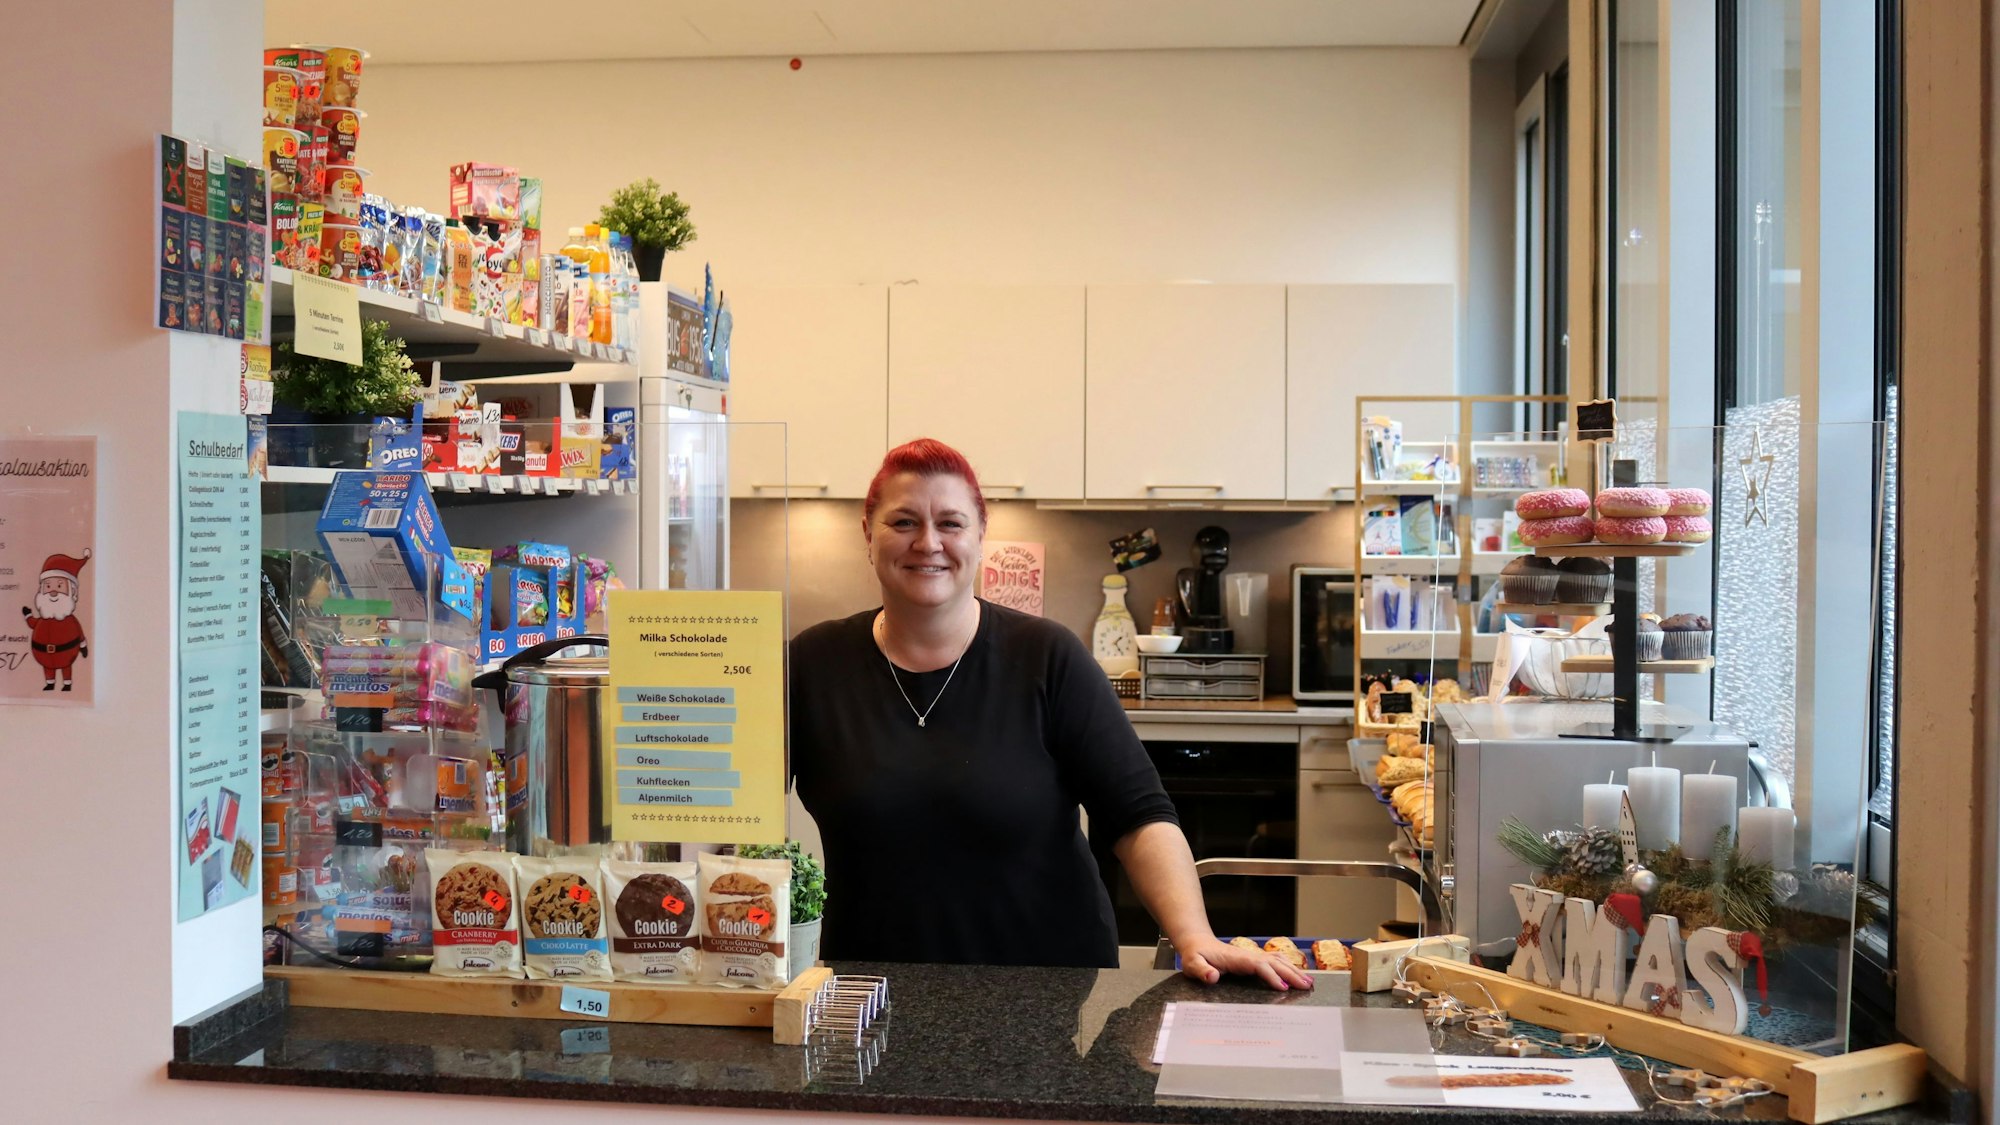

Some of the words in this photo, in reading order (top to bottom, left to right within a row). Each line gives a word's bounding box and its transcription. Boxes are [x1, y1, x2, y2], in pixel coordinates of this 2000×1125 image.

[189, 440, 244, 458] Schulbedarf
[381, 448, 418, 464] OREO
[376, 474, 411, 482] HARIBO
[370, 490, 382, 498] 50
[984, 566, 1040, 591] DINGE
[8, 635, 29, 643] euch!
[640, 634, 667, 642] Milka
[670, 634, 728, 643] Schokolade
[723, 665, 752, 676] 2,50€
[330, 682, 390, 692] mentos
[637, 693, 667, 702] Weiße
[668, 694, 726, 704] Schokolade
[642, 712, 680, 722] Erdbeer
[635, 734, 710, 744] Luftschokolade
[636, 755, 660, 766] Oreo
[636, 776, 690, 787] Kuhflecken
[638, 793, 693, 804] Alpenmilch
[574, 890, 582, 900] 3
[667, 900, 676, 910] 2
[454, 910, 494, 926] Cookie
[542, 920, 584, 935] Cookie
[634, 919, 678, 935] Cookie
[718, 918, 761, 936] Cookie
[452, 930, 498, 938] CRANBERRY
[720, 945, 762, 954] CIOCCOLATO
[1506, 884, 1748, 1035] XMAS
[644, 966, 676, 976] falcone
[726, 968, 755, 978] falcone
[577, 999, 602, 1012] 1,50
